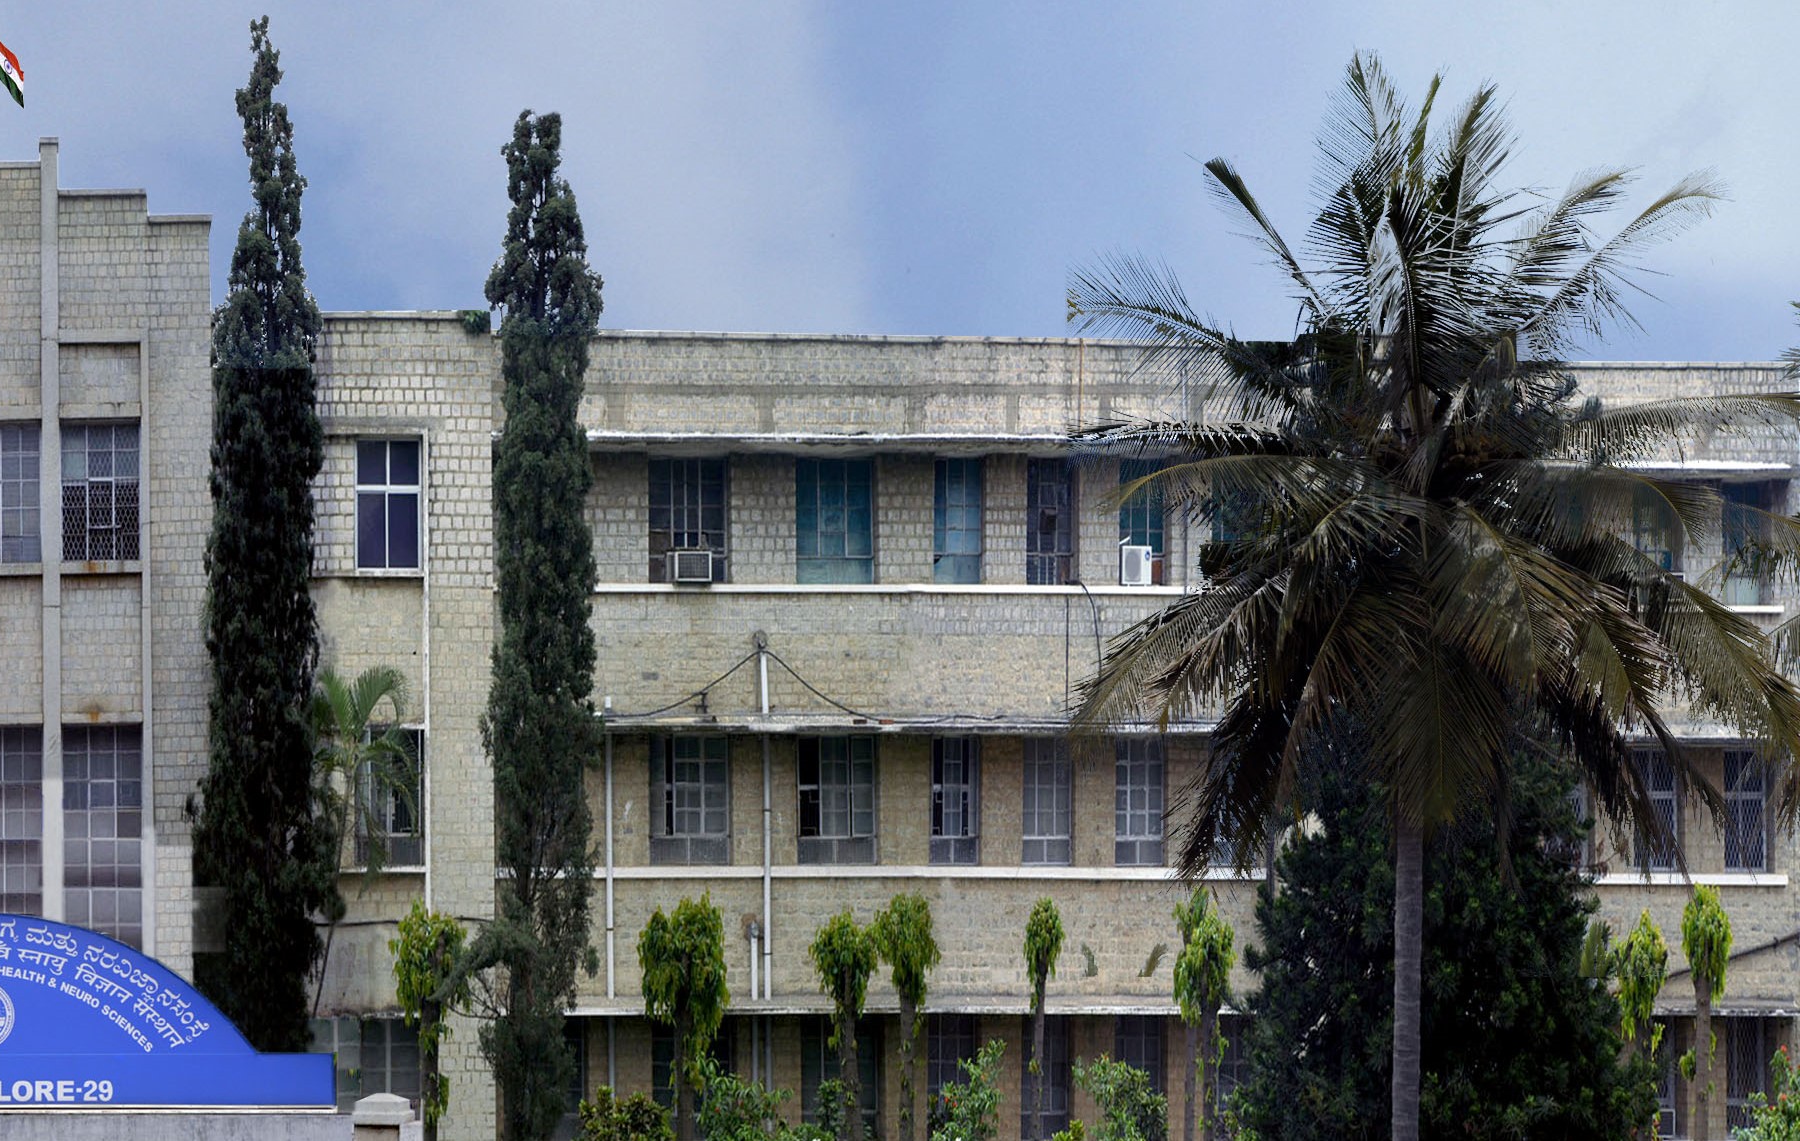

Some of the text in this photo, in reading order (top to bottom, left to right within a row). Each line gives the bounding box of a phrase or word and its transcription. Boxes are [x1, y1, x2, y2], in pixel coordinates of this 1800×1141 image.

[25, 925, 78, 957] ಮತ್ತು
[16, 948, 68, 976] स्नायु
[74, 963, 133, 1004] विज्ञान
[47, 977, 57, 989] &
[60, 981, 100, 1008] NEURO
[101, 1004, 154, 1053] SCIENCES
